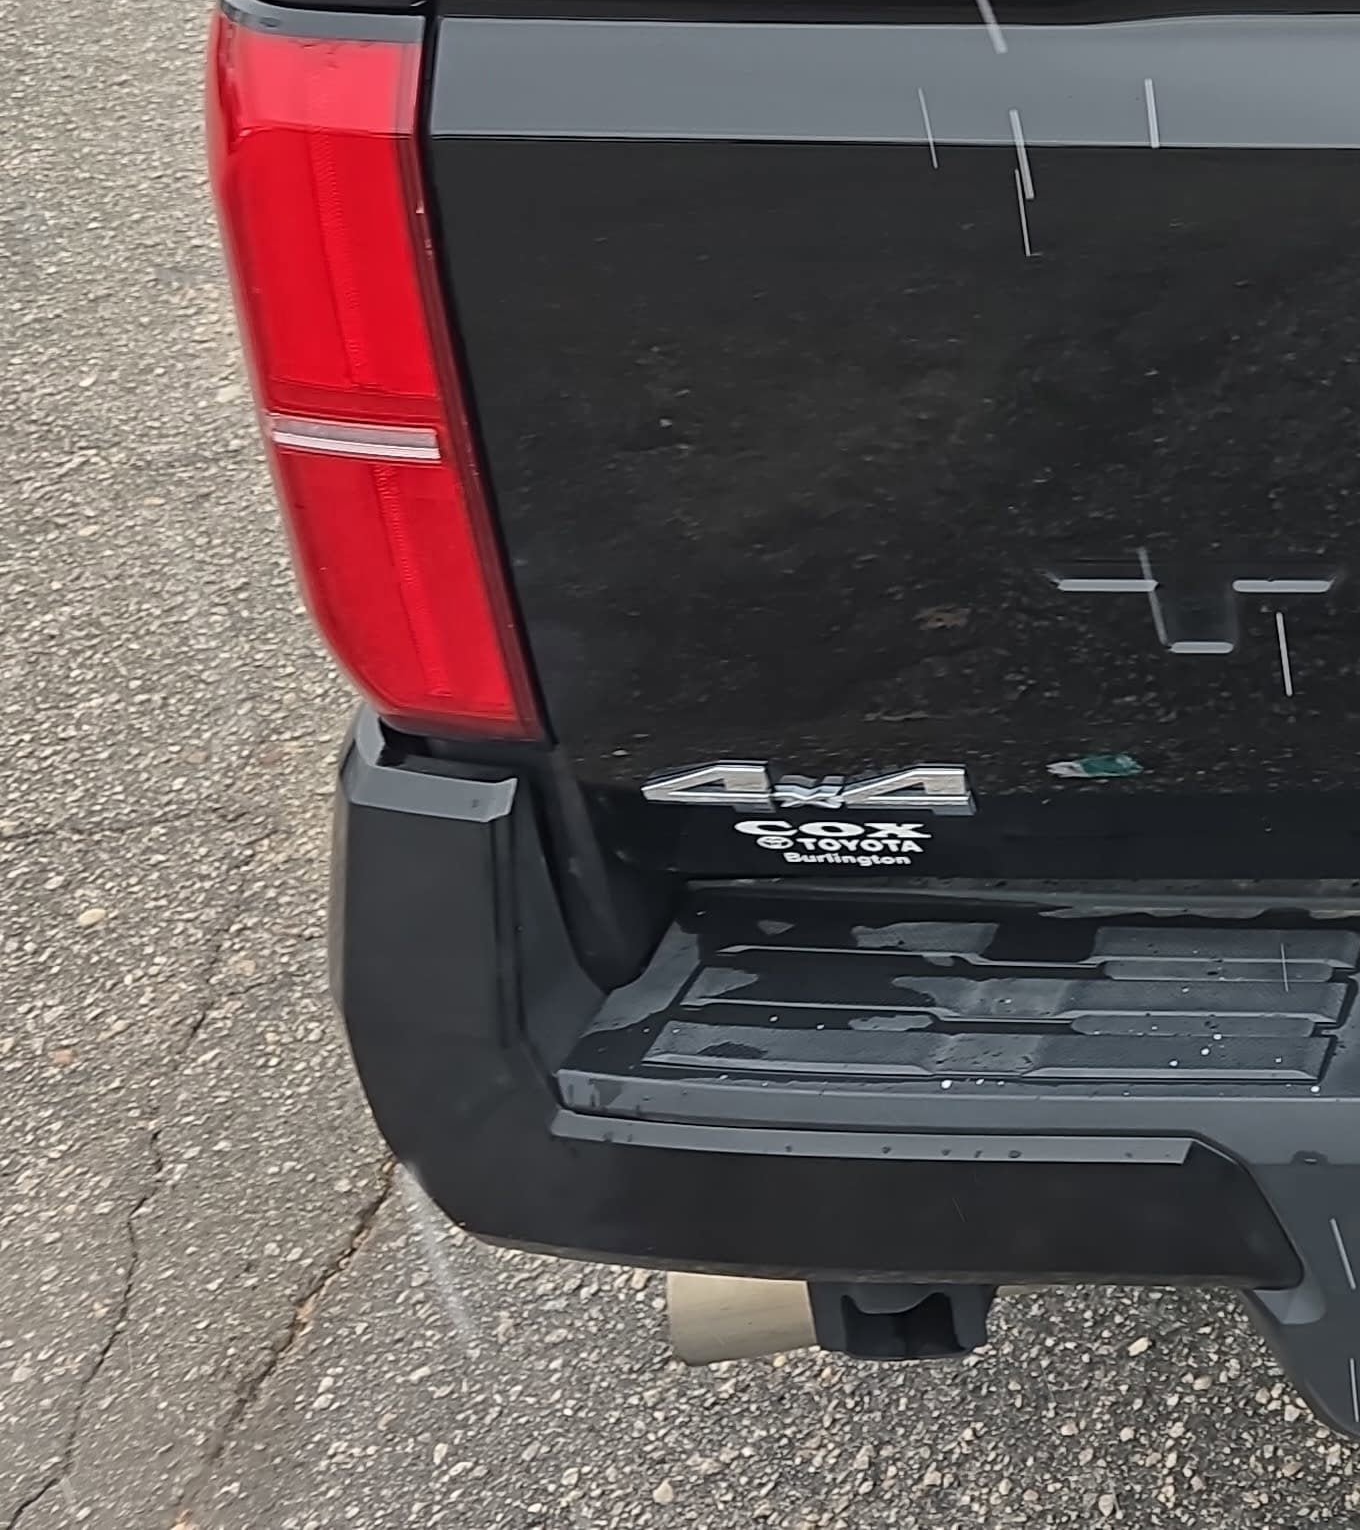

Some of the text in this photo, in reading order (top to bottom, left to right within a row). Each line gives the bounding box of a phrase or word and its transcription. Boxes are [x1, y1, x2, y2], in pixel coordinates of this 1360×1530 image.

[734, 820, 932, 838] COX
[796, 837, 924, 853] TOYOTA
[784, 852, 912, 867] Burlington
